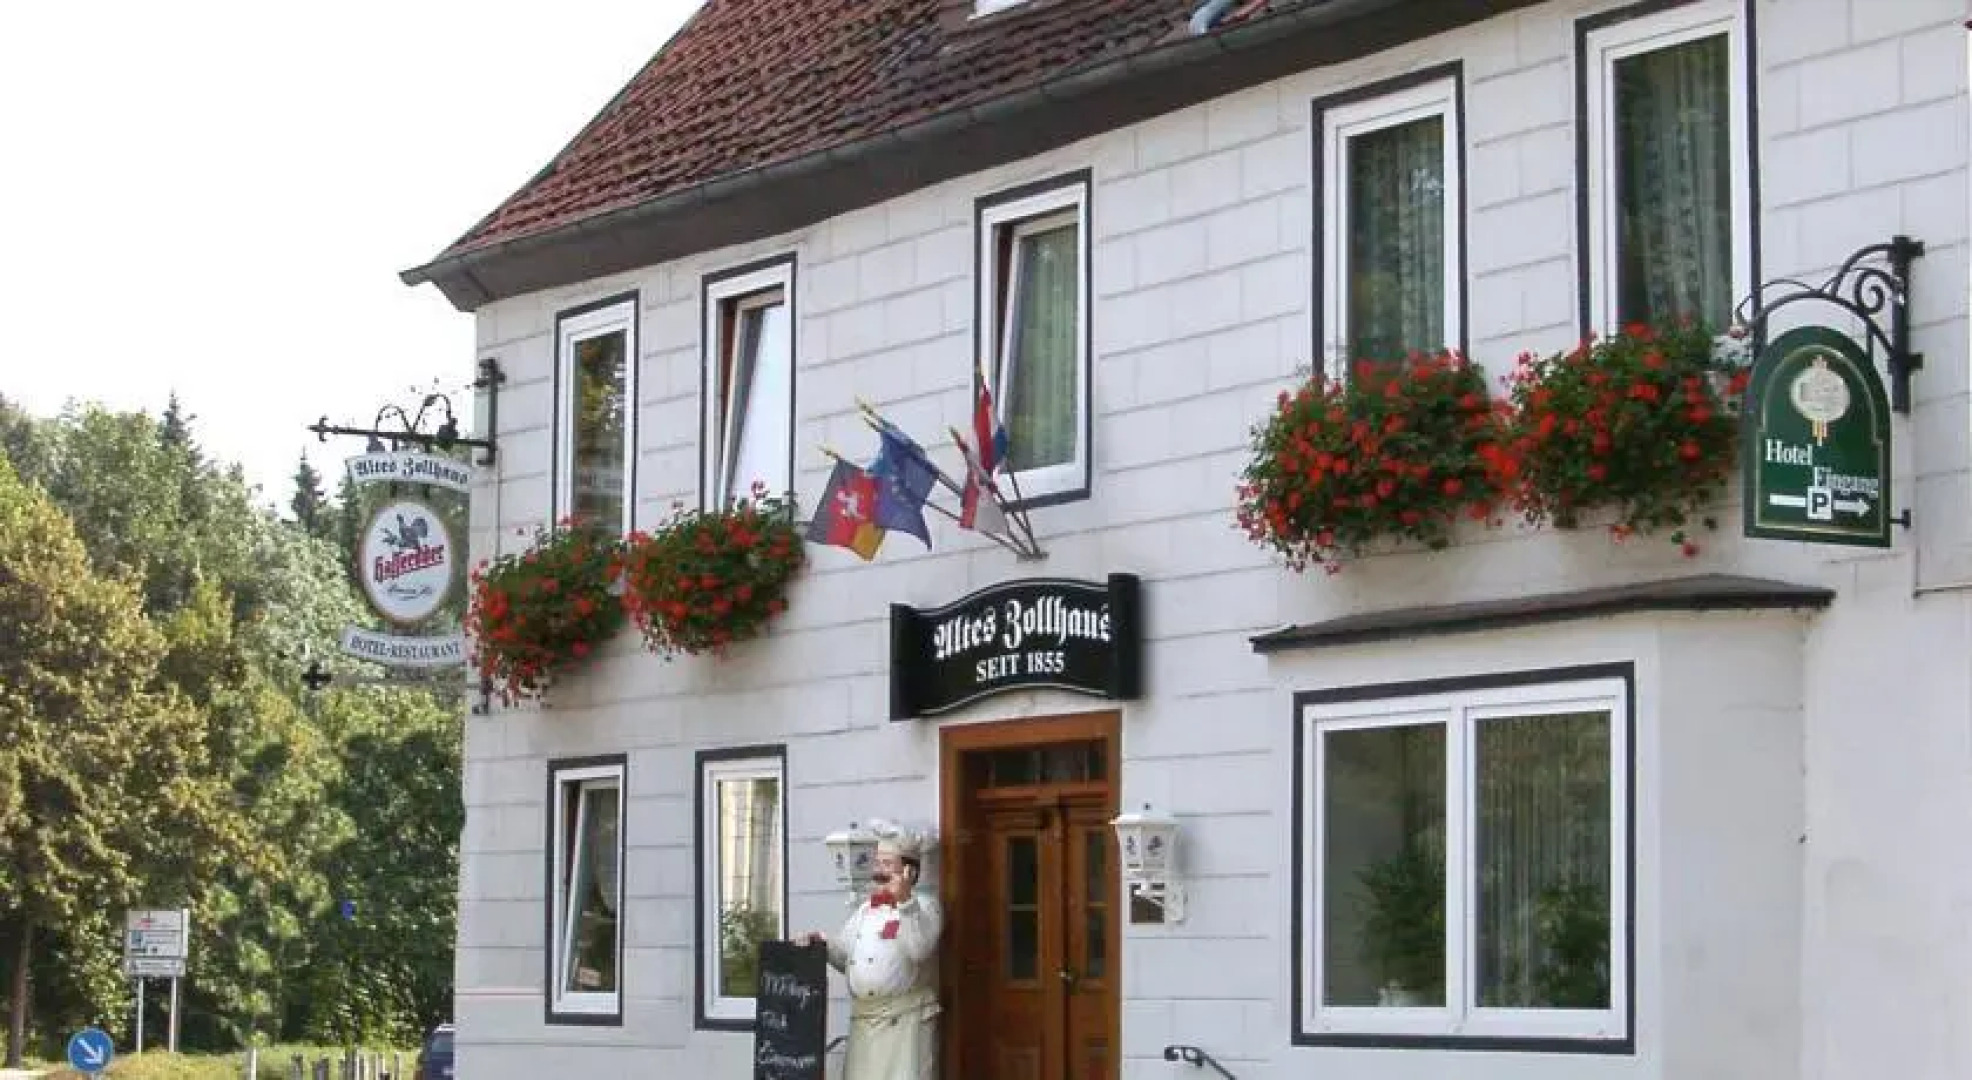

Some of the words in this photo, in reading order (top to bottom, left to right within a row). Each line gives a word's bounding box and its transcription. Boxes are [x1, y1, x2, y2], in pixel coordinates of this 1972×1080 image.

[1765, 438, 1813, 466] Hotel
[354, 459, 398, 476] Altes
[402, 456, 469, 485] Zollhaus
[1813, 466, 1879, 499] Eingang
[933, 605, 997, 660] Altes
[1002, 595, 1111, 649] Zollhaus
[976, 653, 1020, 683] SEIT
[1027, 651, 1065, 675] 1855
